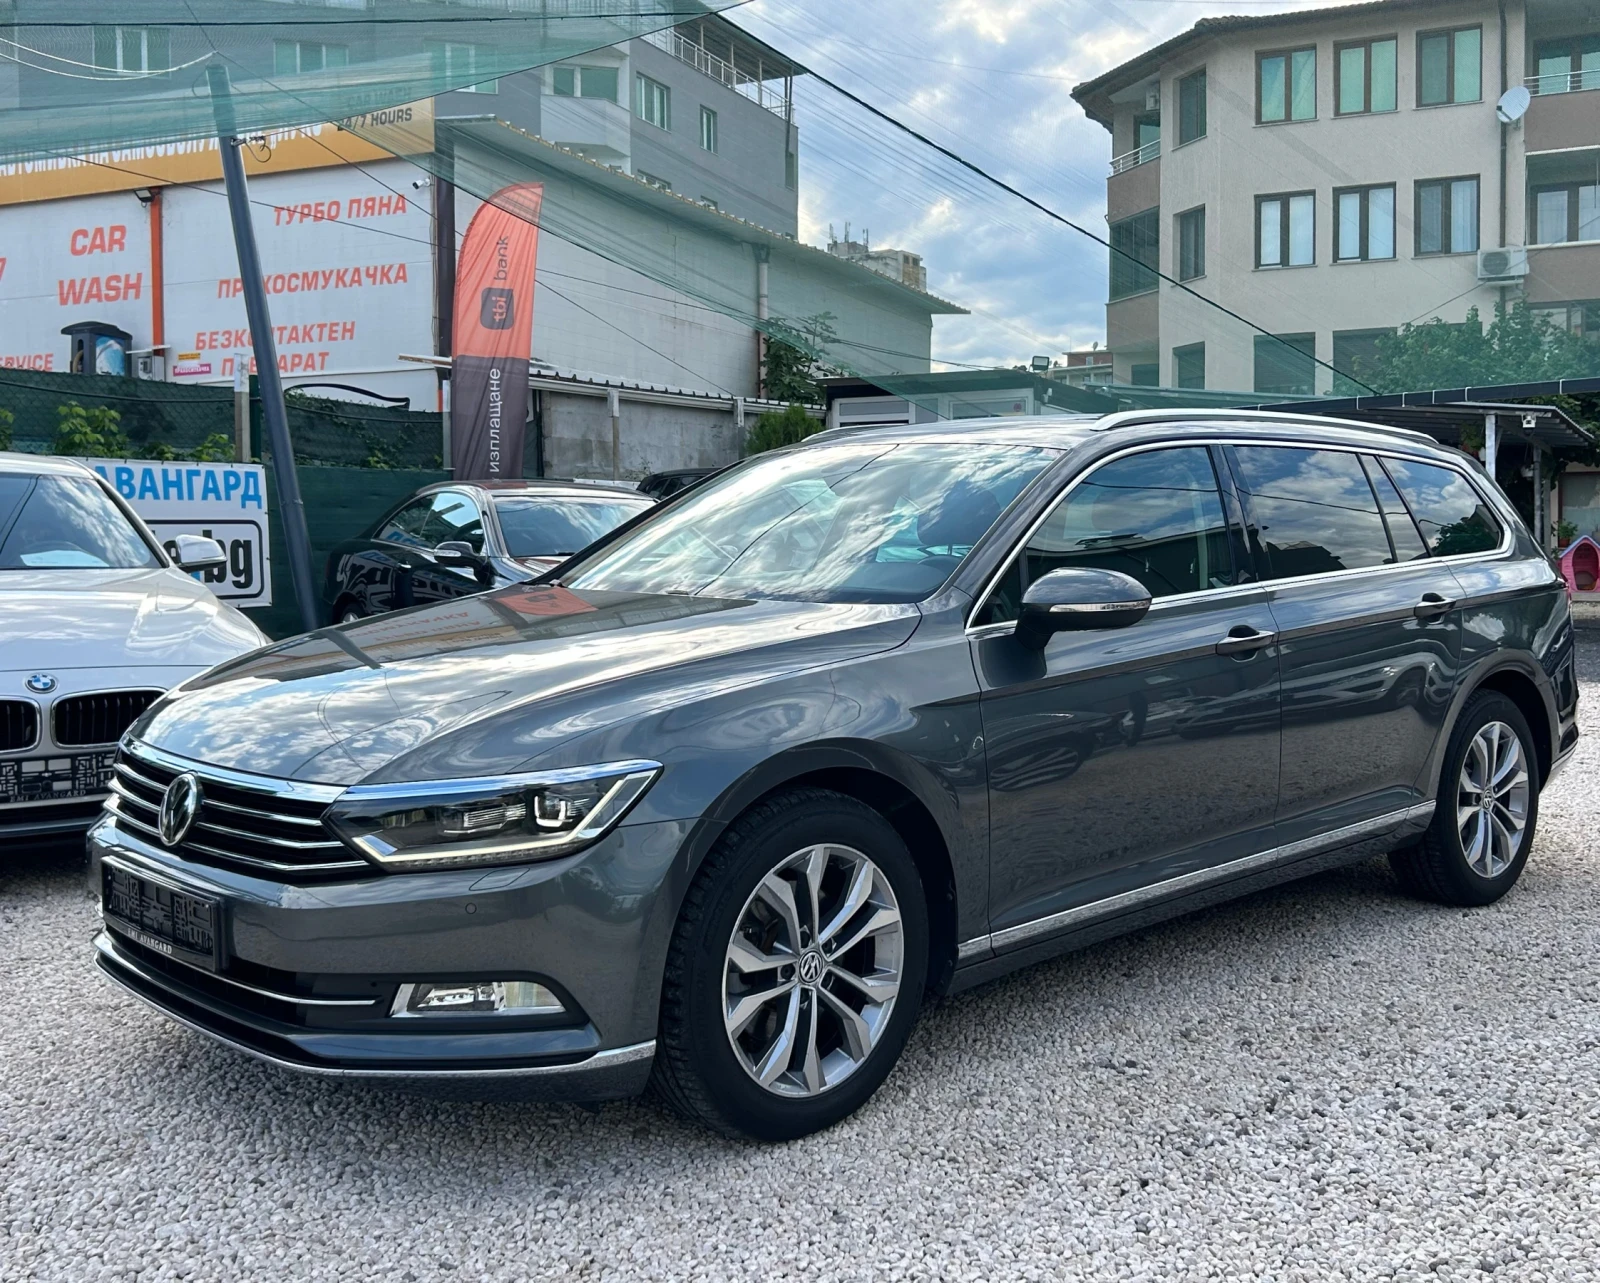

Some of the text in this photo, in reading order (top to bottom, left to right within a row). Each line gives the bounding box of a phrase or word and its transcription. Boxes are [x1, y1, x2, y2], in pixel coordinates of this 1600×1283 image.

[370, 107, 413, 127] HOURS
[274, 194, 407, 226] ТУРБО ПЯНА
[70, 224, 127, 256] CAR
[57, 272, 143, 306] WASH
[217, 262, 408, 299] ПРХОСМУКАЧКА
[492, 235, 510, 323] tbi bank
[195, 320, 356, 351] БЕЗКТАКТЕН
[221, 351, 330, 377] ПЕАРАТ
[489, 368, 503, 473] изплащане
[140, 933, 173, 954] AVANGARD
